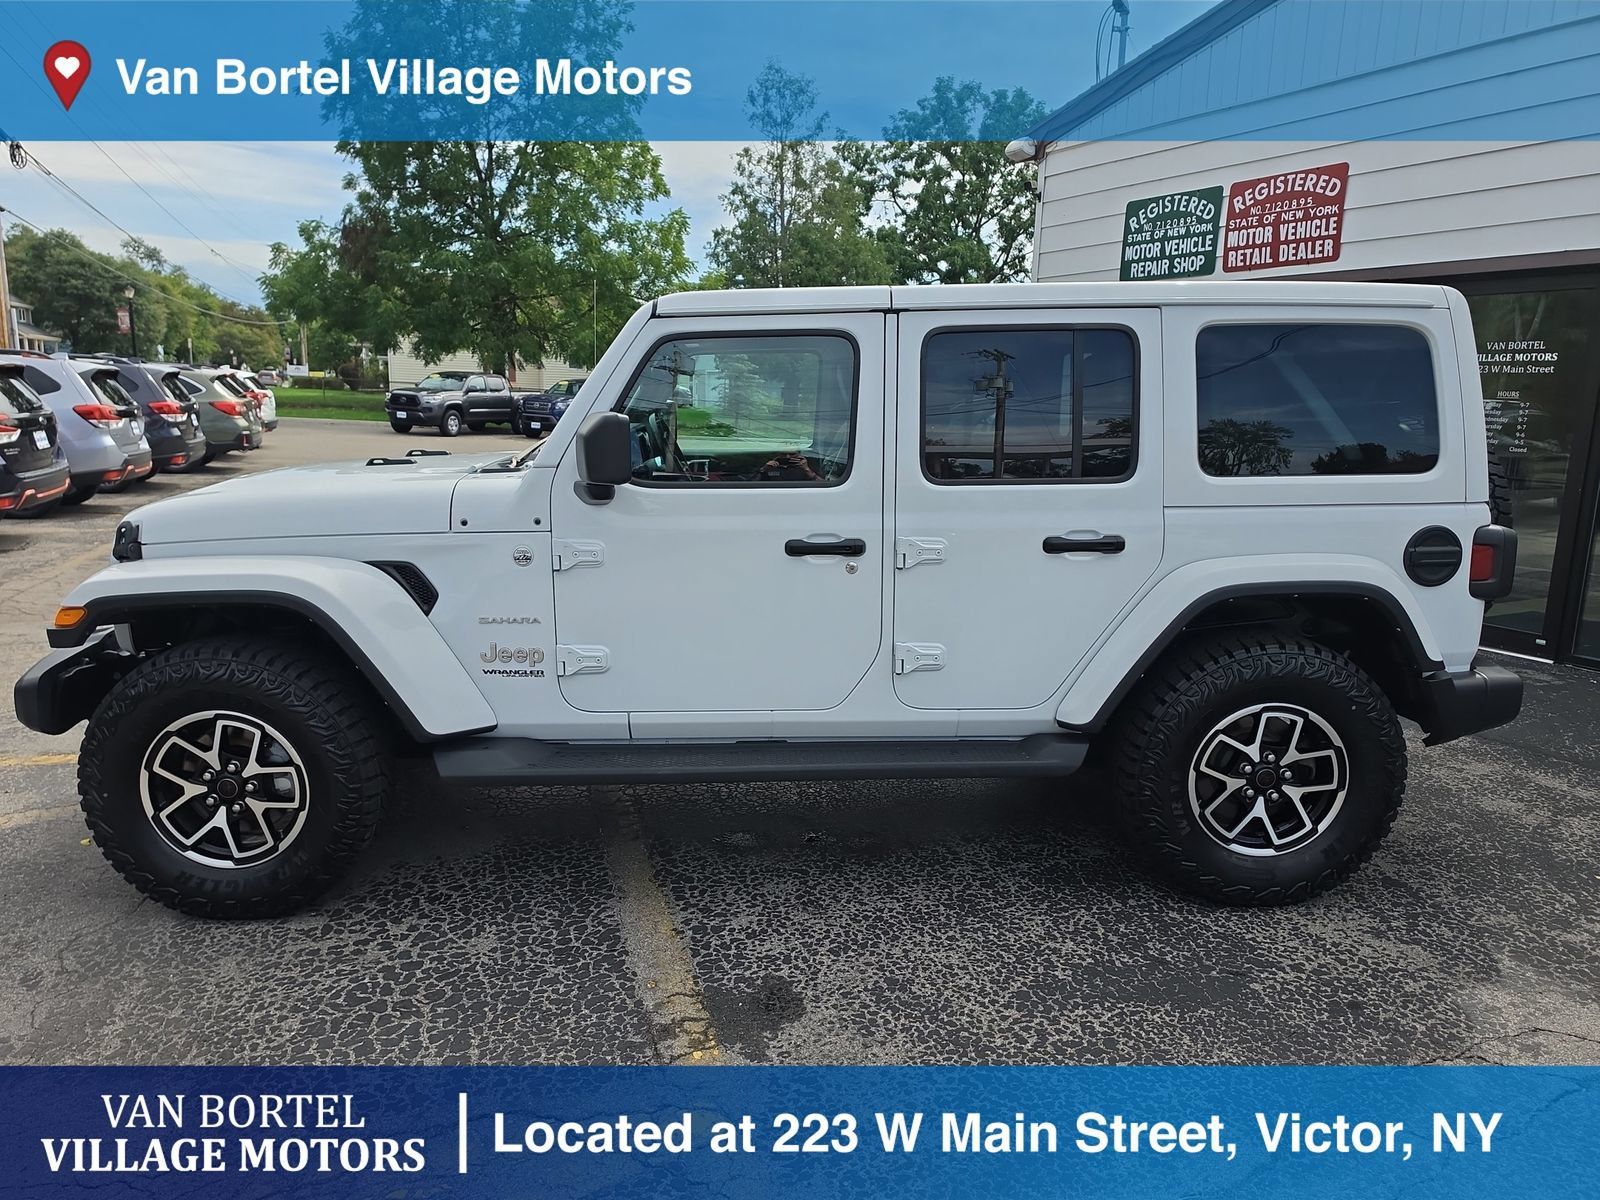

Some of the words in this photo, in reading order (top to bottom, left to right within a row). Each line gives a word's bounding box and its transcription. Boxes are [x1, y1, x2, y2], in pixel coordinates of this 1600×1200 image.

[1233, 173, 1341, 213] REGISTERED
[1265, 197, 1313, 212] 7120895
[1129, 195, 1215, 232] REGISTERED
[1156, 216, 1197, 230] 7120895
[1229, 217, 1259, 228] STATE
[1263, 213, 1277, 224] OF
[1281, 210, 1304, 221] NEW
[1309, 204, 1339, 217] YORK
[1127, 232, 1151, 243] STATE
[1154, 230, 1165, 239] OF
[1167, 227, 1186, 237] NEW
[1189, 222, 1213, 234] YORK
[1227, 226, 1273, 248] MOTOR
[1280, 217, 1338, 241] VEHICLE
[1125, 242, 1161, 261] MOTOR
[1164, 235, 1213, 256] VEHICLE
[1228, 246, 1273, 268] RETAIL
[1279, 239, 1333, 262] DEALER
[1130, 259, 1169, 278] REPAIR
[1173, 255, 1205, 273] SHOP
[1487, 342, 1506, 350] VAN
[1508, 341, 1546, 350] BORTEL
[1514, 352, 1558, 361] MOTORS
[1479, 365, 1489, 373] 23
[1491, 365, 1501, 373] W
[1502, 365, 1524, 373] Main
[1526, 365, 1555, 373] Street
[480, 642, 544, 667] Jeep
